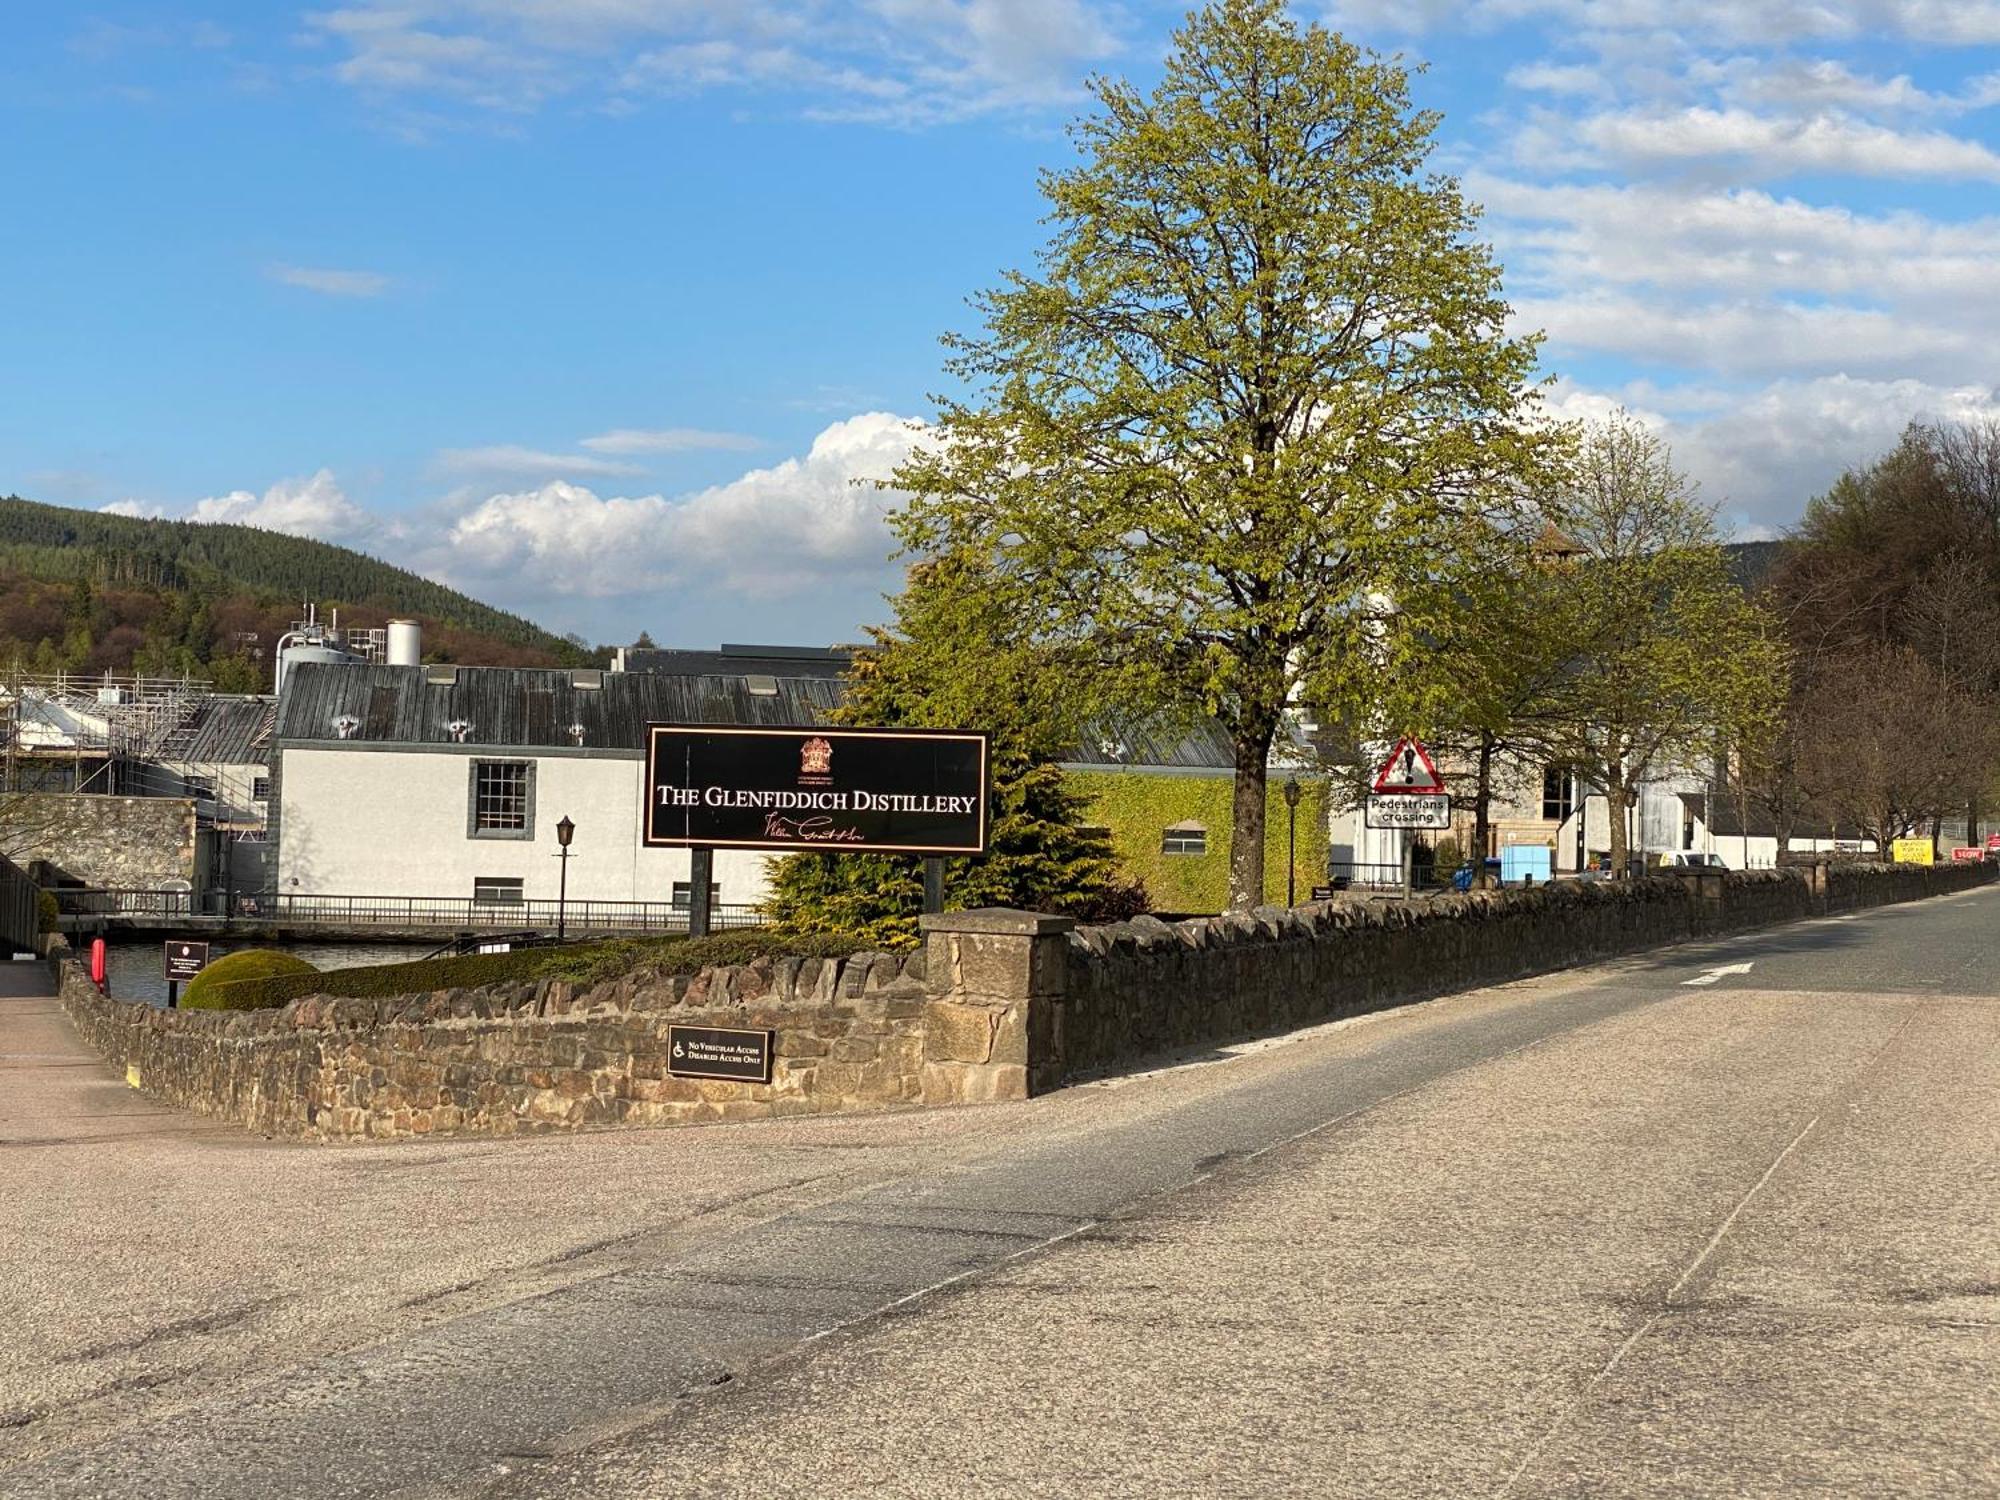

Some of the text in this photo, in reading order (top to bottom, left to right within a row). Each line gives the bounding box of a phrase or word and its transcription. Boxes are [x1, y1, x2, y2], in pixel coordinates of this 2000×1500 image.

[657, 785, 977, 813] THE GLENFIDDICH DISTILLERY
[1371, 799, 1444, 809] Pedestrians
[1382, 811, 1434, 823] crossing
[1957, 850, 1980, 859] SLOW
